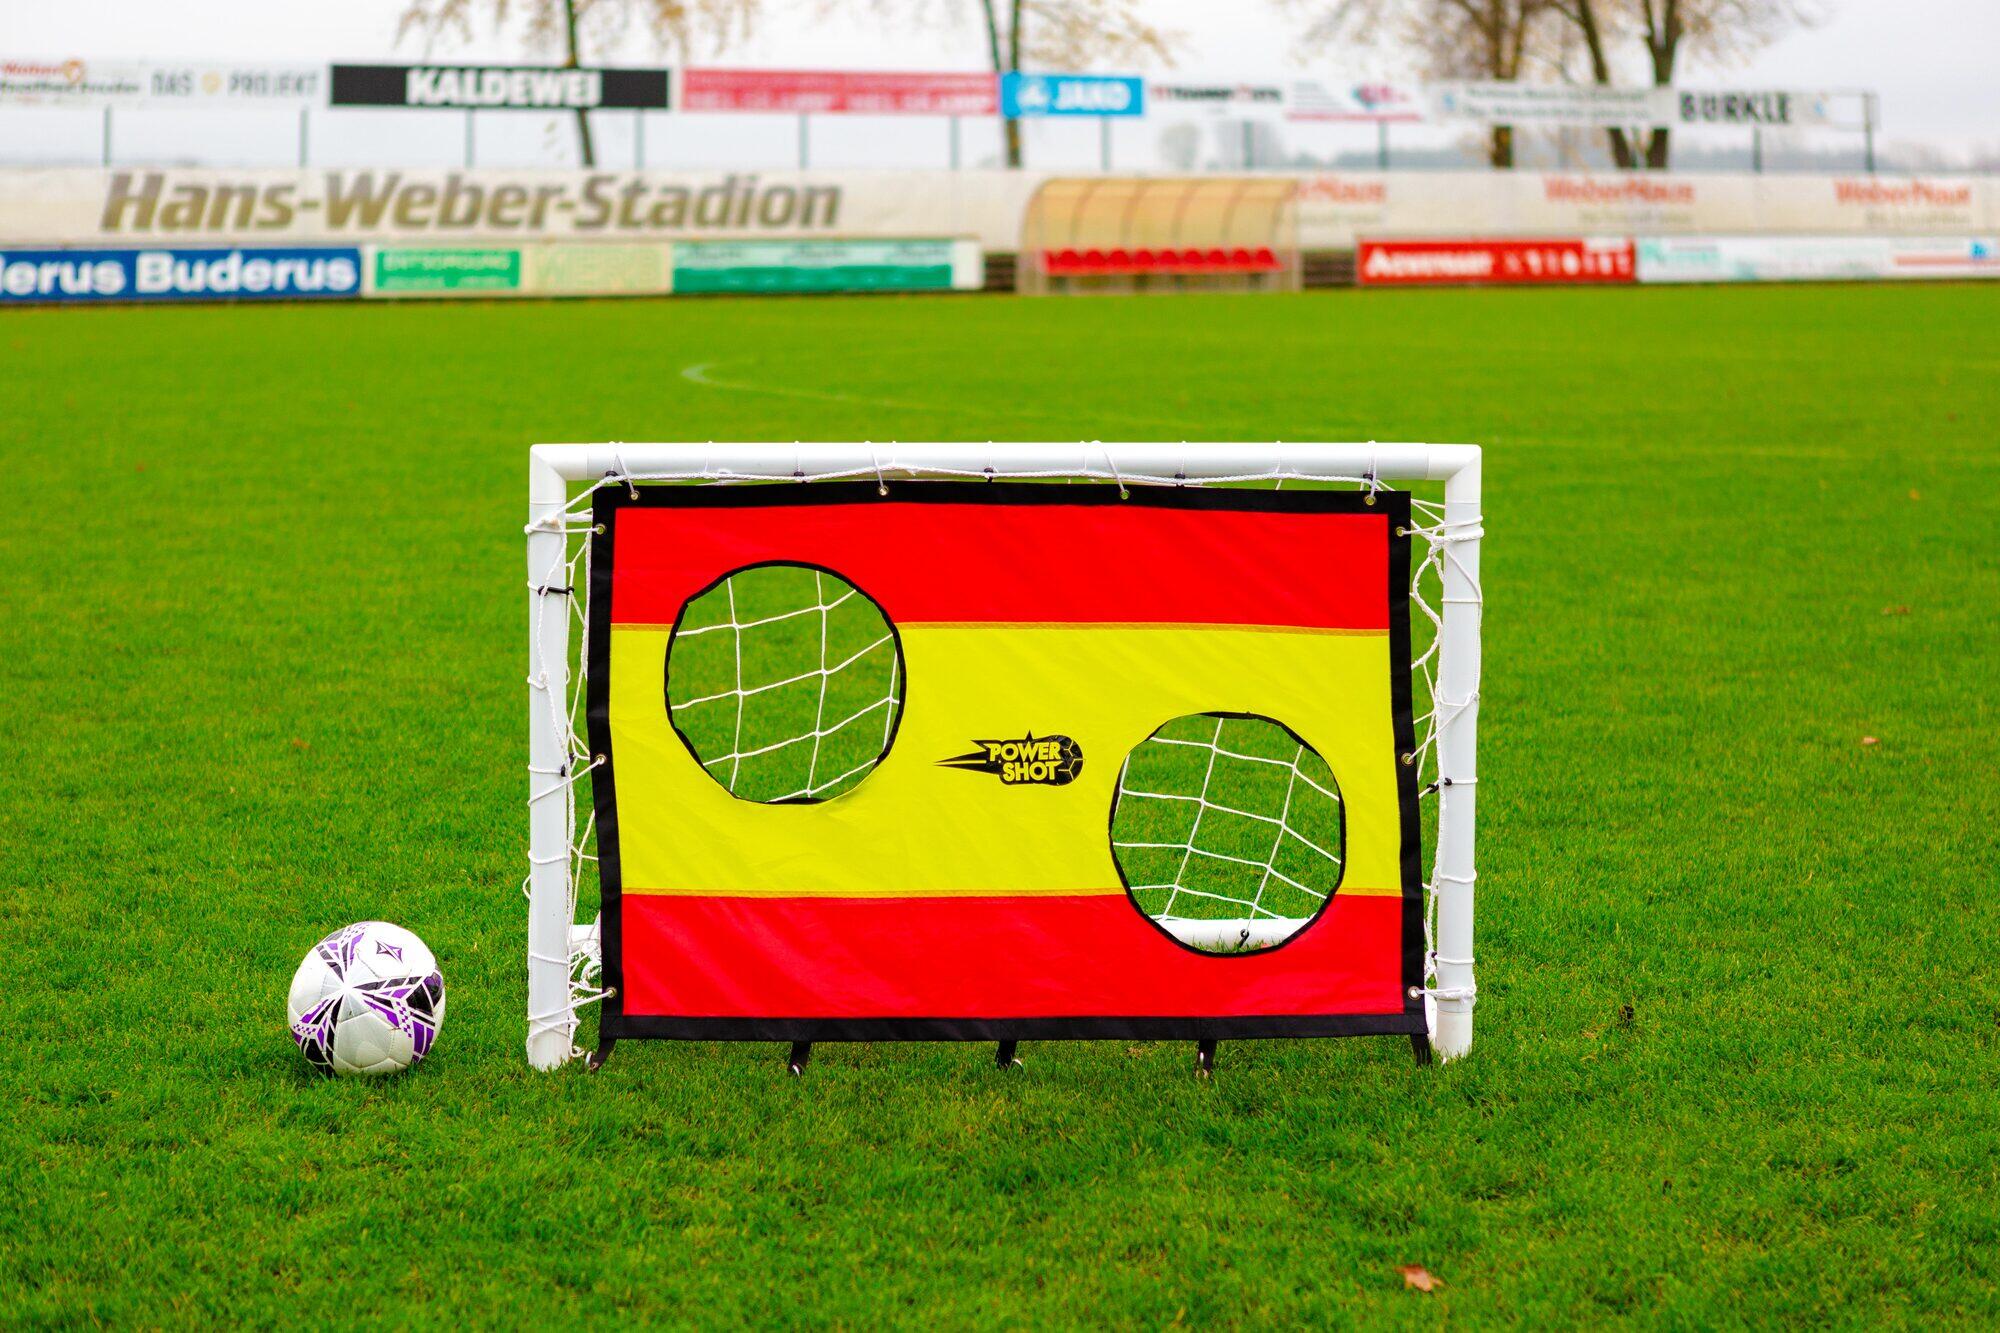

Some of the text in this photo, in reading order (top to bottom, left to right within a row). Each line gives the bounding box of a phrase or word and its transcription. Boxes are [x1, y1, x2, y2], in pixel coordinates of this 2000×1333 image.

[405, 68, 600, 107] KALDEWEI
[100, 171, 842, 231] Hans-Weber-Stadion
[0, 250, 358, 296] erus Buderus
[983, 742, 1062, 762] POWER
[1002, 760, 1064, 782] SHOT
